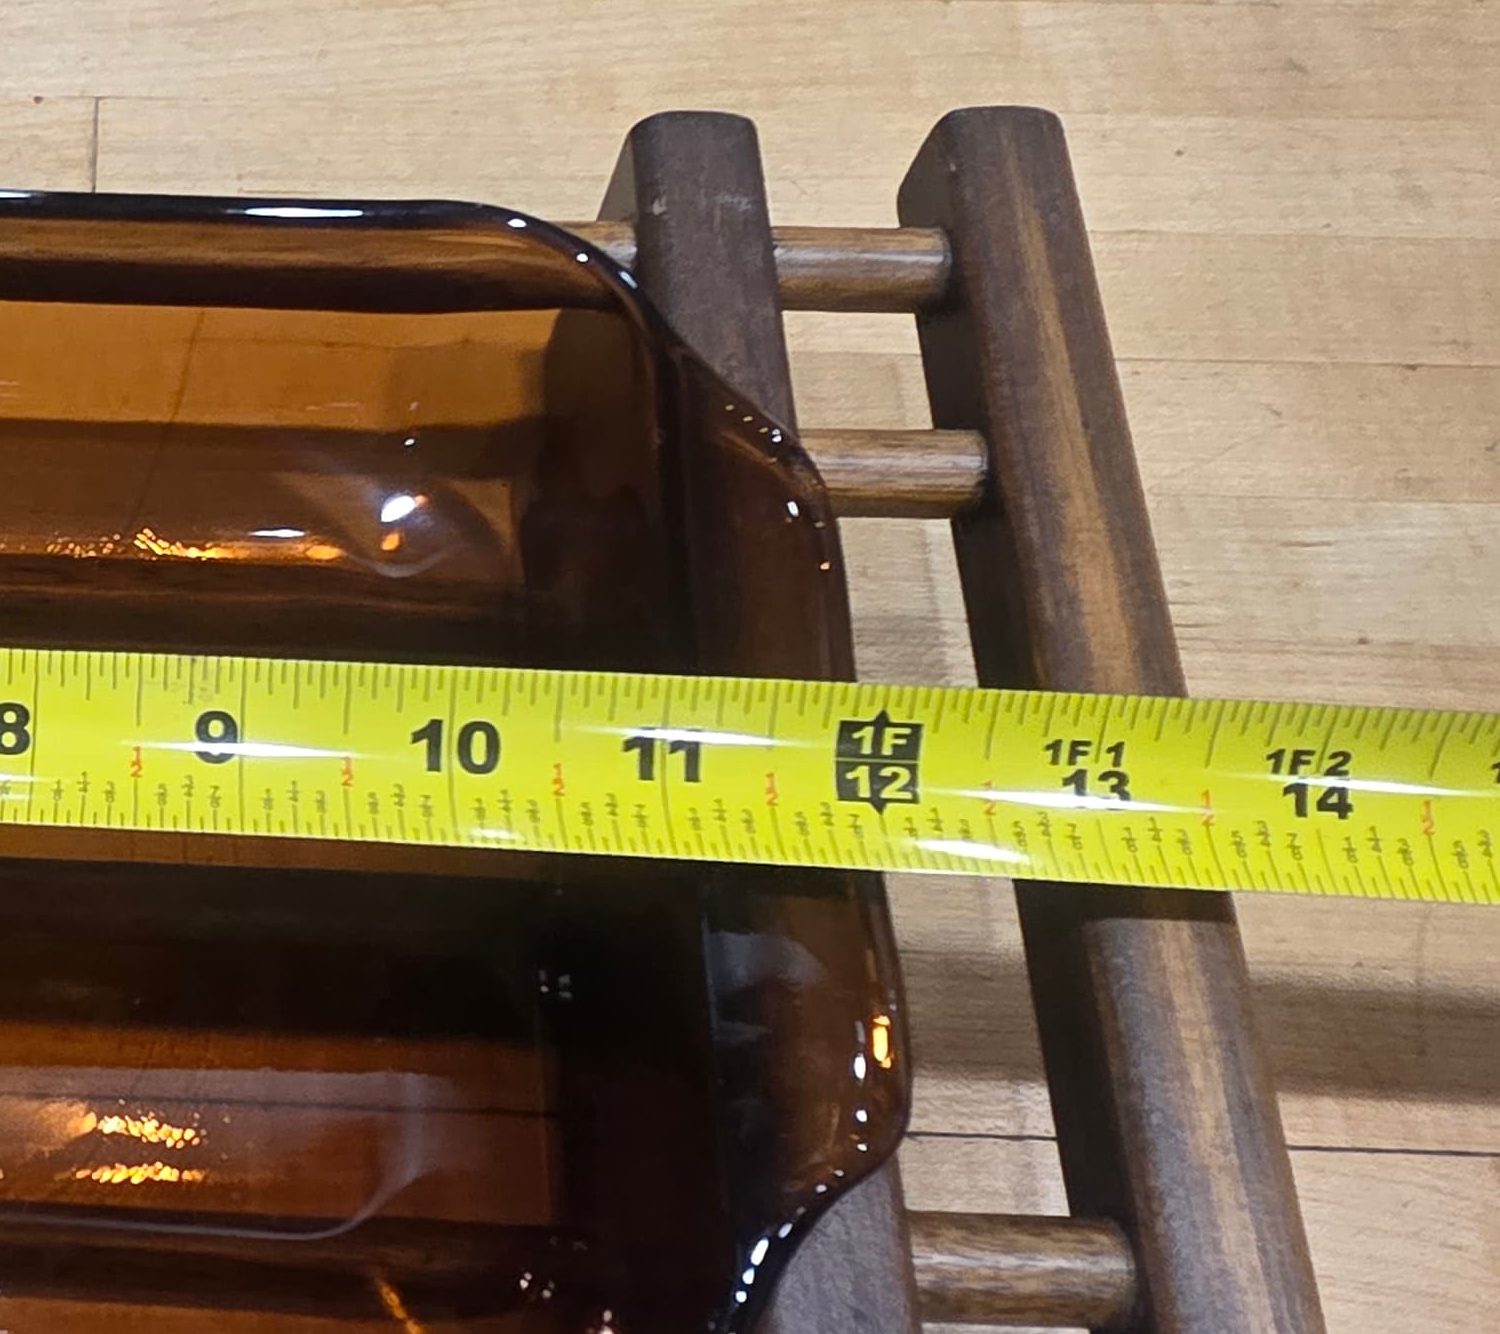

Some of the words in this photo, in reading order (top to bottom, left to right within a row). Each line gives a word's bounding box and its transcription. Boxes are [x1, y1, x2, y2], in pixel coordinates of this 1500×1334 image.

[194, 710, 238, 764] 9
[410, 718, 500, 775] 10
[622, 727, 702, 783] 11
[851, 725, 912, 756] 1F
[845, 765, 913, 799] 12
[1062, 768, 1131, 810] 13
[1282, 782, 1354, 820] 14
